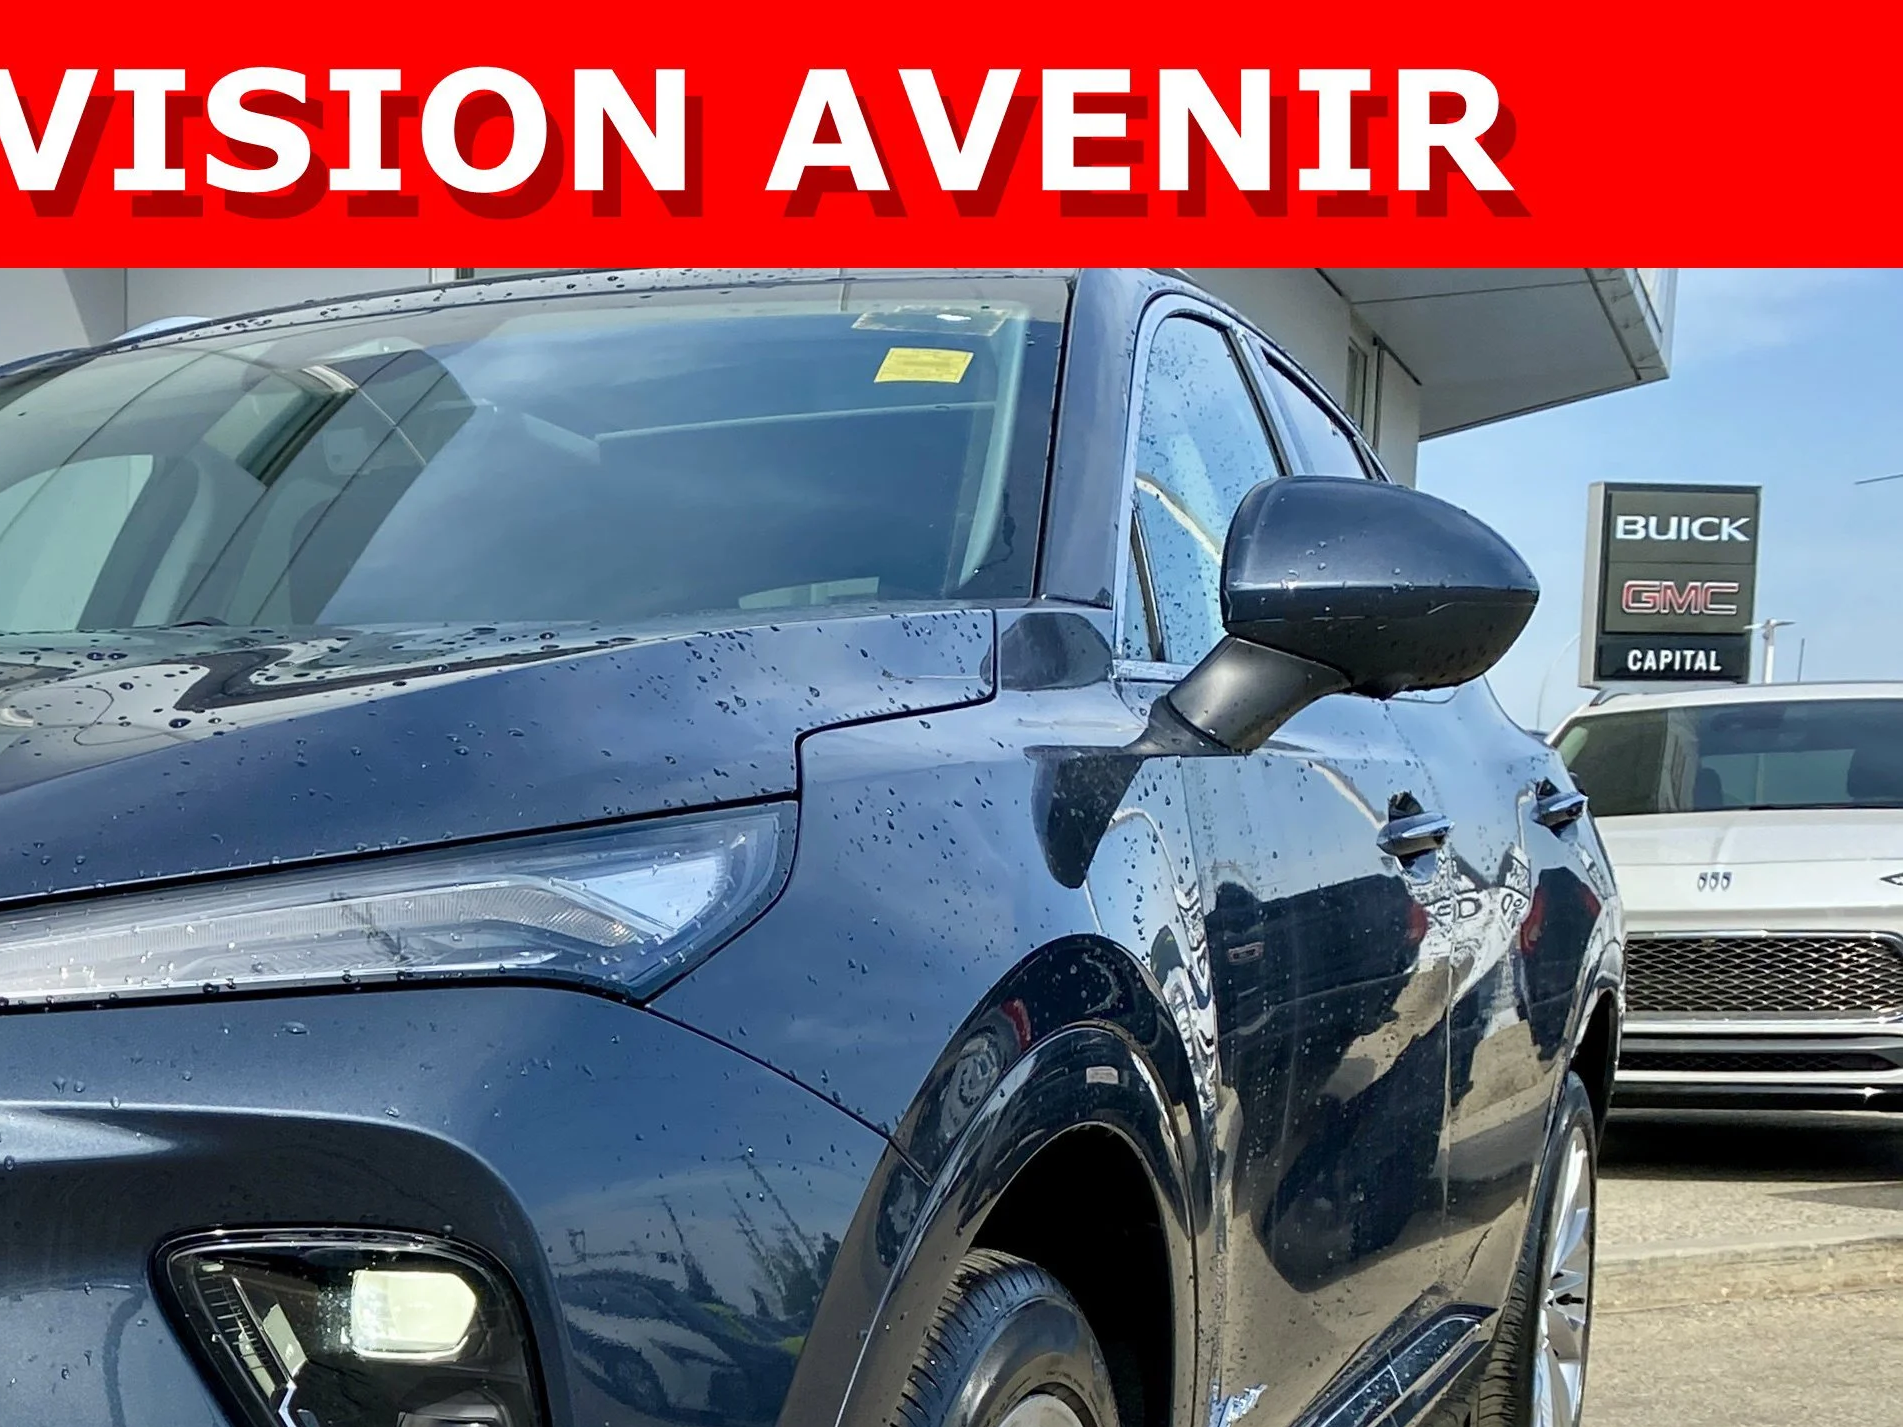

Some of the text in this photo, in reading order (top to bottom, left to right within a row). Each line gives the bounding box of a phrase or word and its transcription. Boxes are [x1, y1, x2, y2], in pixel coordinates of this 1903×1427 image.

[1615, 514, 1751, 542] BUICK
[1622, 579, 1740, 616] GMC
[1627, 648, 1723, 673] CAPITAL
